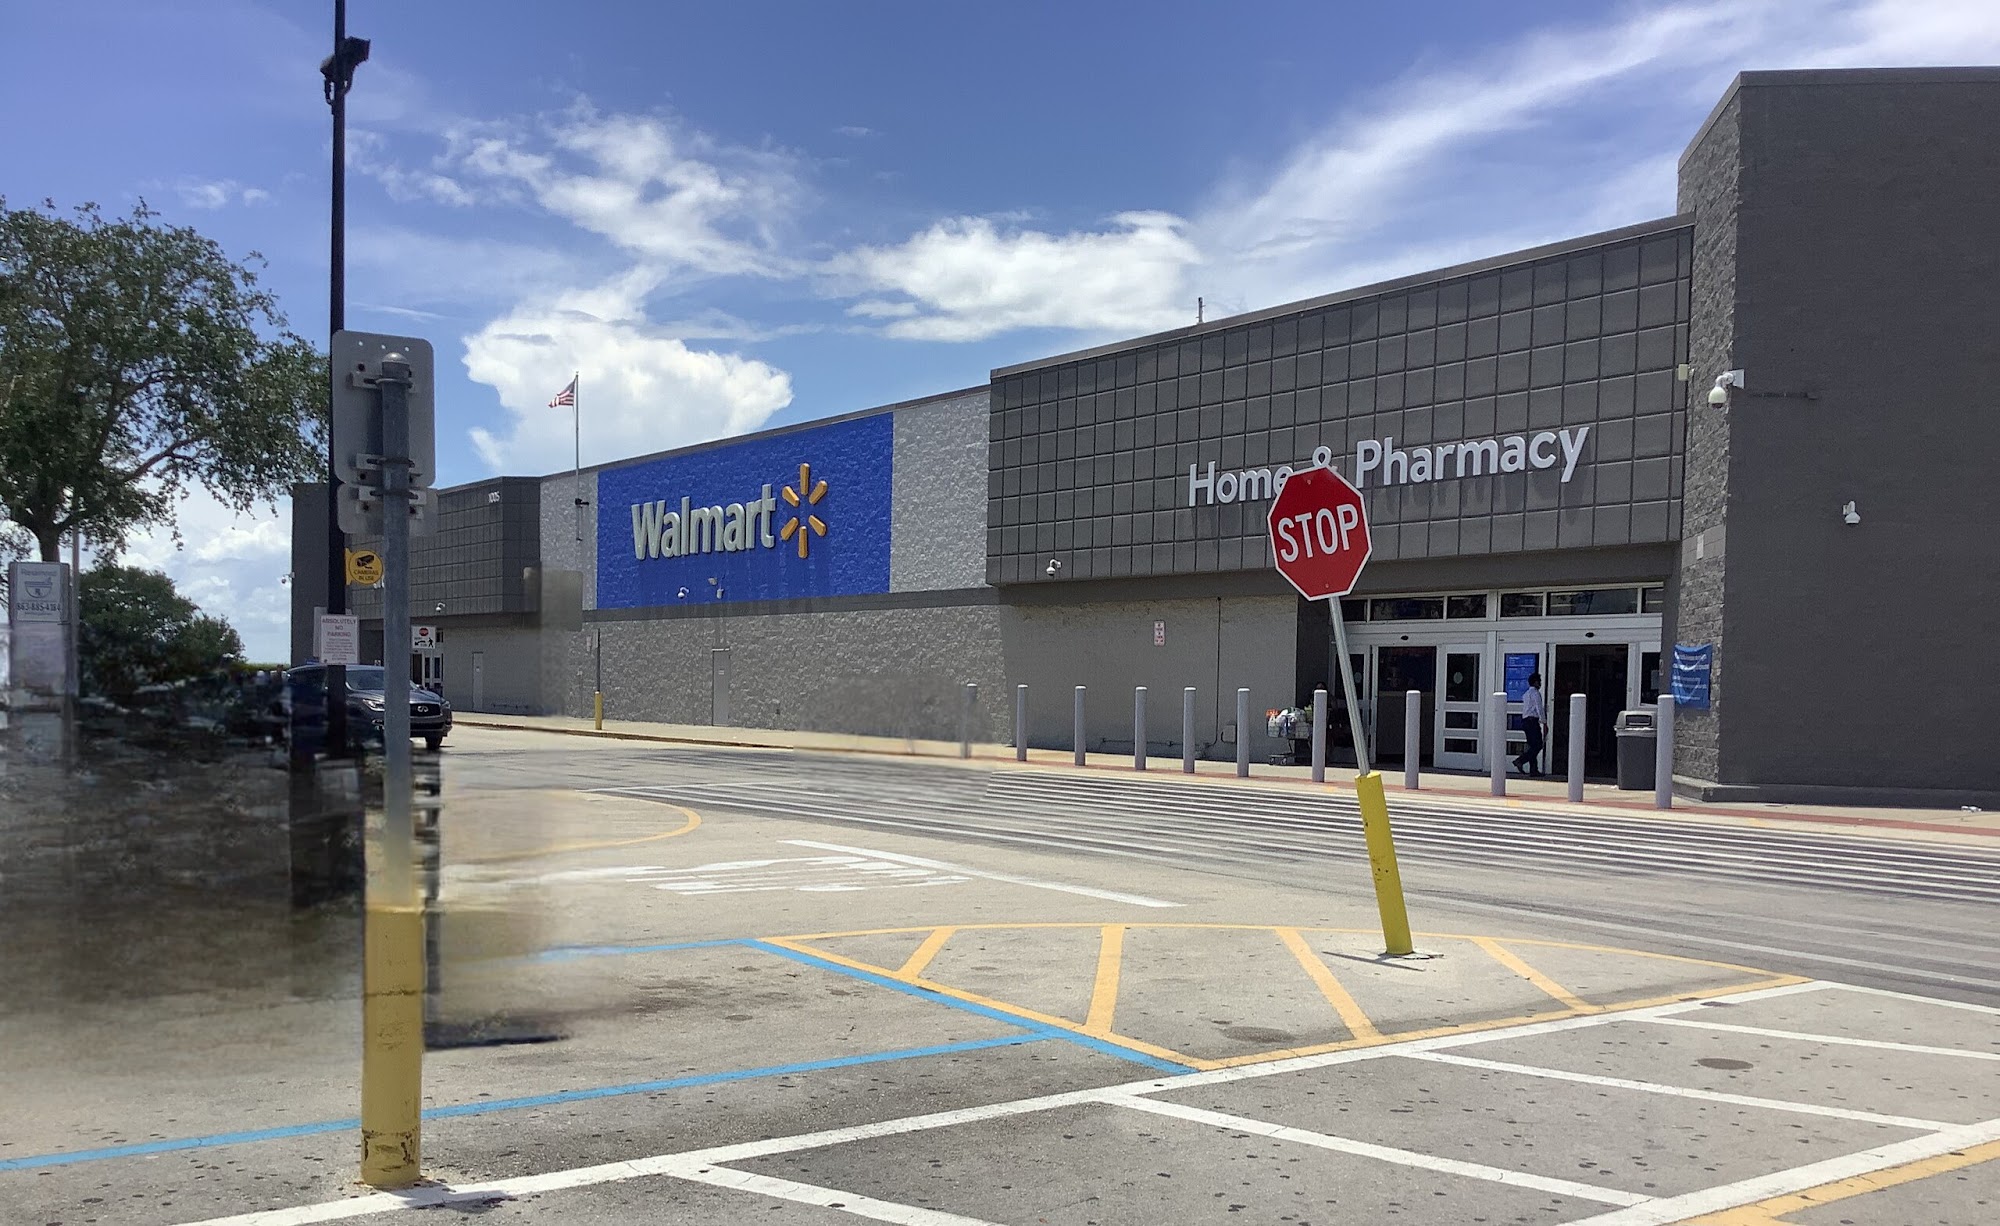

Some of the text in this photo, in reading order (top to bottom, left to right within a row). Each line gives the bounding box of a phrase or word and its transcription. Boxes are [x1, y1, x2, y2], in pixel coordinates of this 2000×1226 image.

[1188, 460, 1294, 507] Home
[1355, 426, 1590, 489] Pharmacy
[631, 483, 776, 560] Walmart
[1278, 503, 1359, 563] STOP
